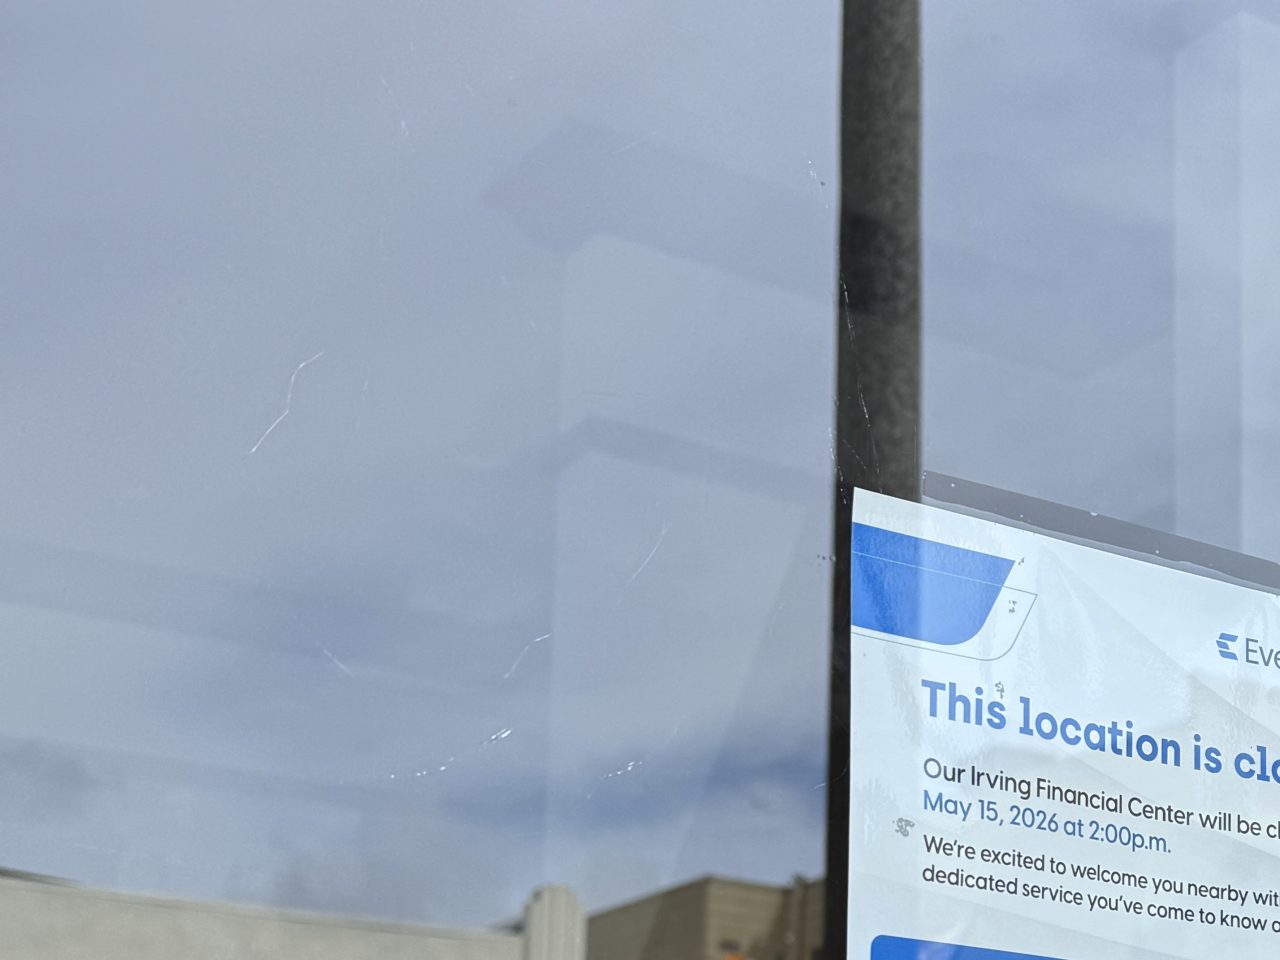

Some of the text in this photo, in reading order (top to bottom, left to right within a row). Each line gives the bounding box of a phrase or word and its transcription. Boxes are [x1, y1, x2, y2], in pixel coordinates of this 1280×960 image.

[922, 680, 1006, 729] This
[1020, 696, 1180, 766] location
[1194, 734, 1222, 773] is
[924, 758, 965, 783] Our
[972, 766, 1030, 800] Irving
[1037, 778, 1122, 813] Financial
[1128, 798, 1194, 825] Center
[1199, 812, 1231, 831] will
[1238, 815, 1261, 836] be
[924, 790, 1170, 852] May 15, 2026 at 2:00p.m.
[923, 865, 1017, 894] dedicated
[1023, 884, 1083, 905] service
[1088, 894, 1142, 914] you've
[1148, 904, 1194, 921] come
[1199, 908, 1215, 924] to
[1221, 910, 1267, 930] know
[924, 835, 975, 859] We're
[981, 849, 1044, 871] excited
[1050, 858, 1066, 874] to
[1071, 864, 1148, 888] welcome
[1152, 878, 1182, 894] you
[1188, 884, 1248, 906] nearby
